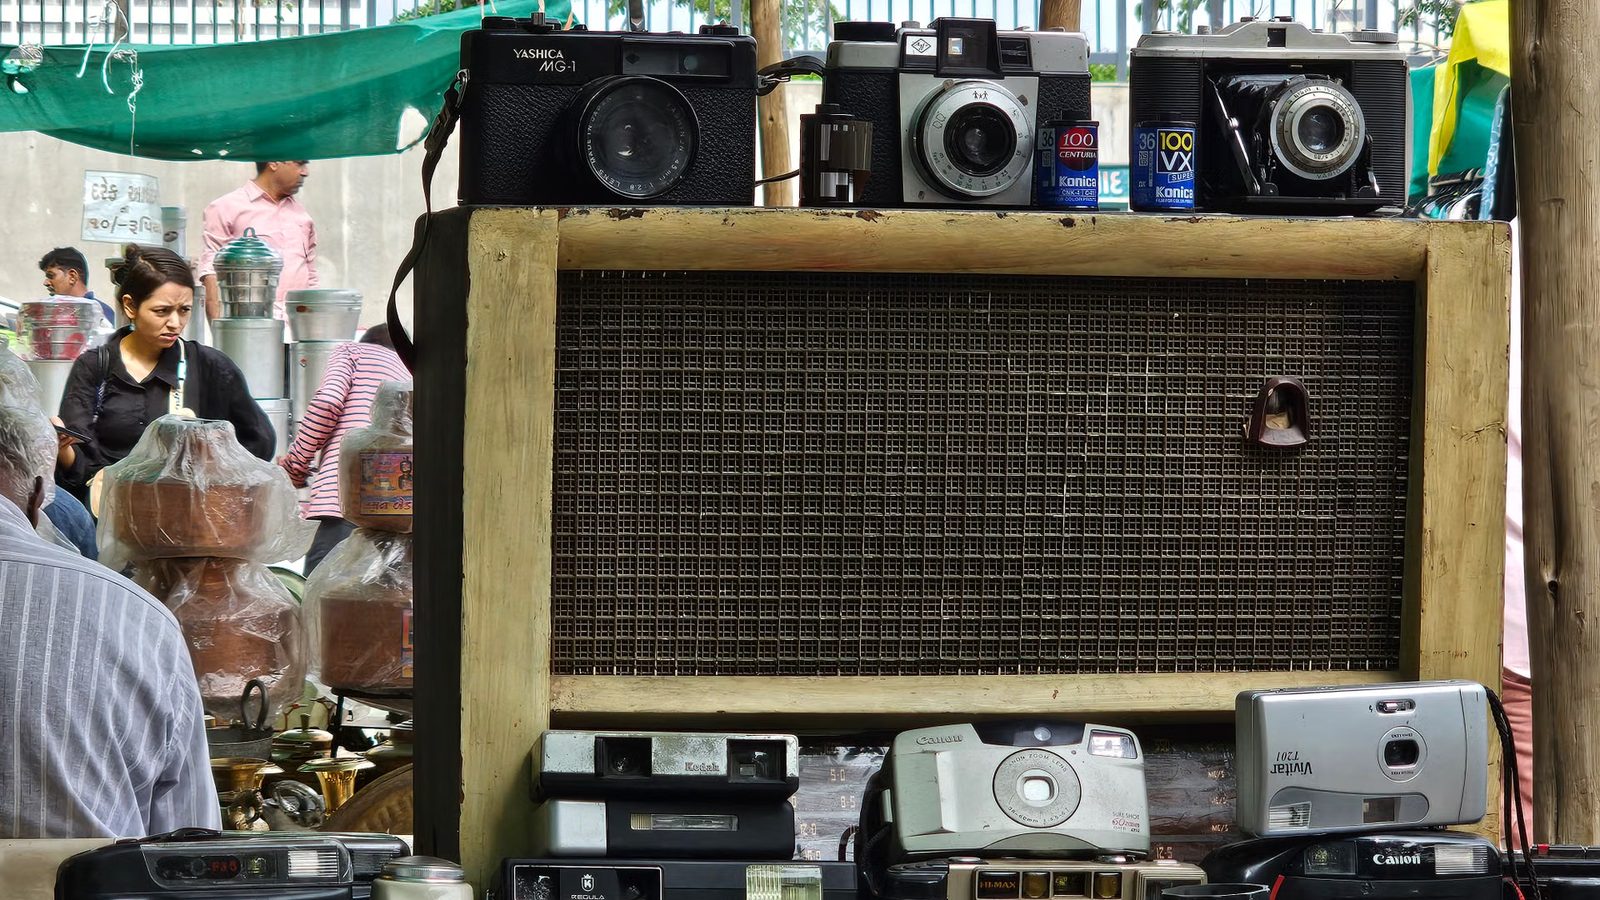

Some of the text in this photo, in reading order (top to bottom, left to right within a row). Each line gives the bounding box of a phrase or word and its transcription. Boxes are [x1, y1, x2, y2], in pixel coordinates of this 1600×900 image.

[513, 48, 564, 59] YASHICA
[539, 60, 576, 72] MG-1
[1042, 131, 1054, 147] 36
[1063, 133, 1094, 147] 100
[1139, 132, 1156, 150] 36
[1160, 132, 1193, 152] 100
[1160, 151, 1192, 171] VX
[1059, 175, 1097, 187] Konica
[1155, 186, 1193, 199] Konica
[915, 734, 964, 746] Canon
[1276, 751, 1300, 762] T201
[684, 762, 720, 772] Kodak
[1270, 761, 1313, 776] Vivitar
[1372, 853, 1421, 866] Canon
